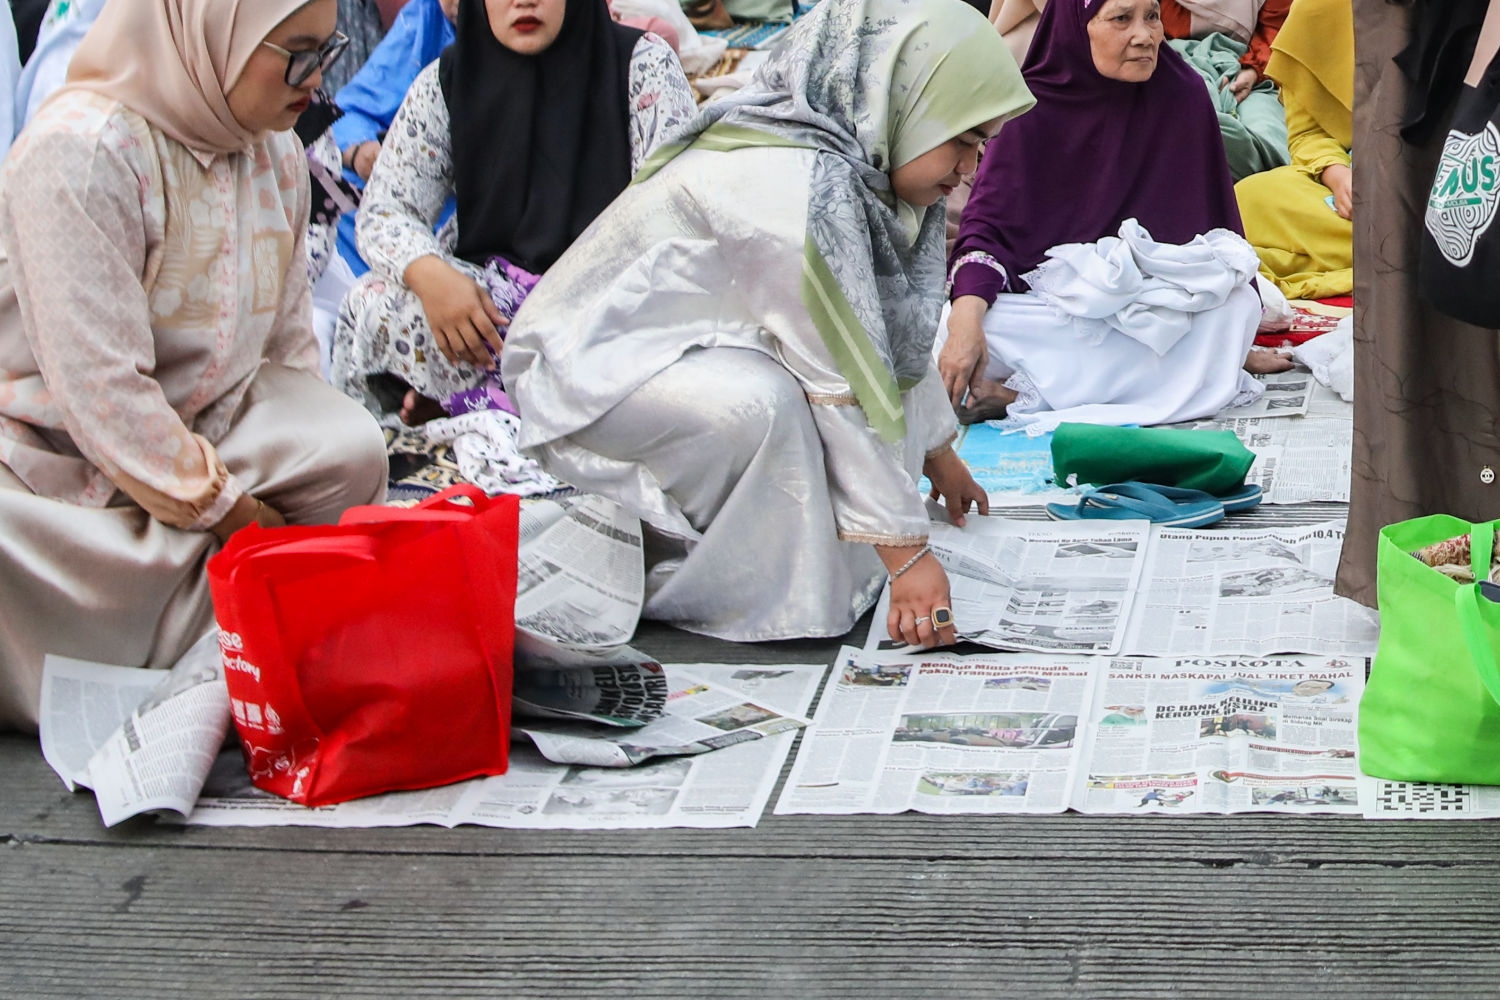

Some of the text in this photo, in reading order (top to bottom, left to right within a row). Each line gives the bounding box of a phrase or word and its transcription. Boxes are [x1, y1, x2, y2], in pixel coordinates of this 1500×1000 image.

[921, 662, 971, 670] Menhub
[1175, 659, 1305, 668] POSKOTA
[1160, 672, 1226, 680] MASKAPAI
[1156, 695, 1278, 713] DC BANK KELILING
[1155, 709, 1220, 719] KEROYOK
